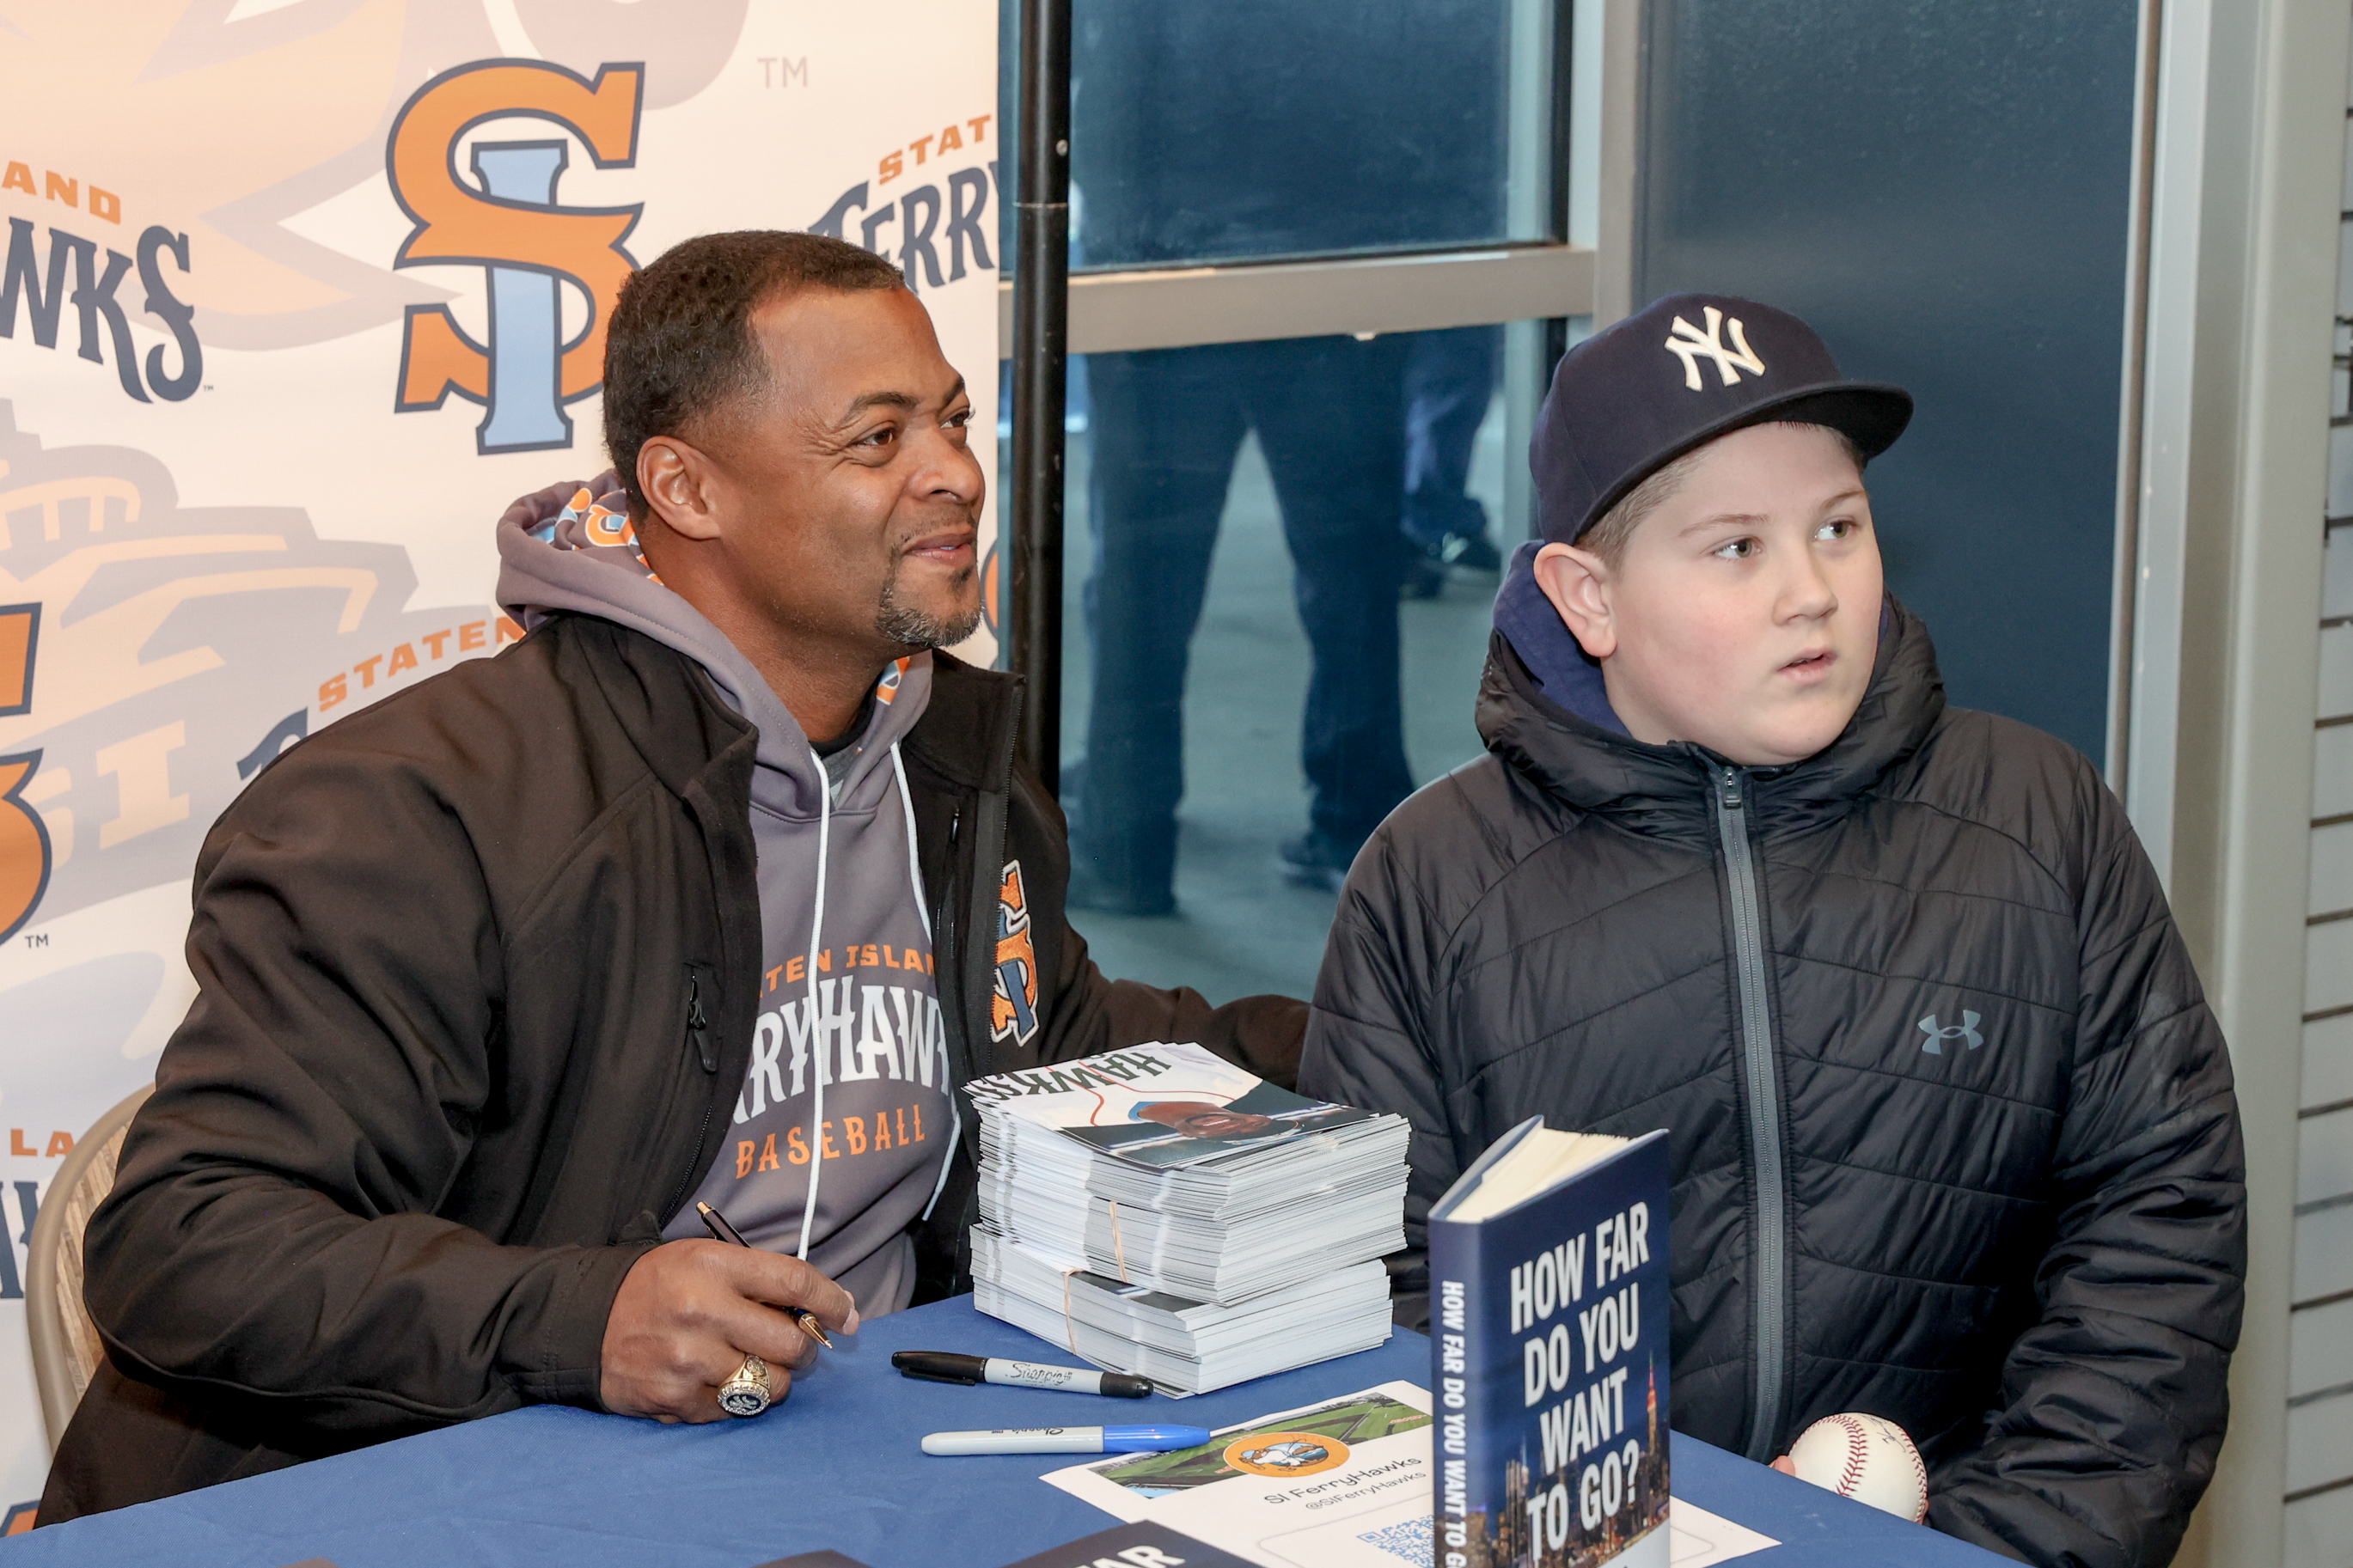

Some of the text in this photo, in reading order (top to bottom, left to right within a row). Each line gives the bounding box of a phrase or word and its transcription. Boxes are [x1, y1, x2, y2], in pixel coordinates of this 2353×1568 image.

[756, 56, 809, 88] TM
[1664, 306, 1766, 392] NY
[25, 934, 49, 949] TM
[759, 949, 832, 998] TEN
[733, 975, 950, 1124] RYHAW
[736, 1104, 926, 1180] BASEBALL
[1511, 1201, 1650, 1334] HOW FAR
[1525, 1282, 1640, 1407] DO YOU
[1442, 1280, 1467, 1568] HOW FAR DO YOU WANT TO G
[1540, 1366, 1628, 1475] WANT
[1289, 1457, 1422, 1498] FerryHawks
[1526, 1438, 1640, 1561] TO GO?
